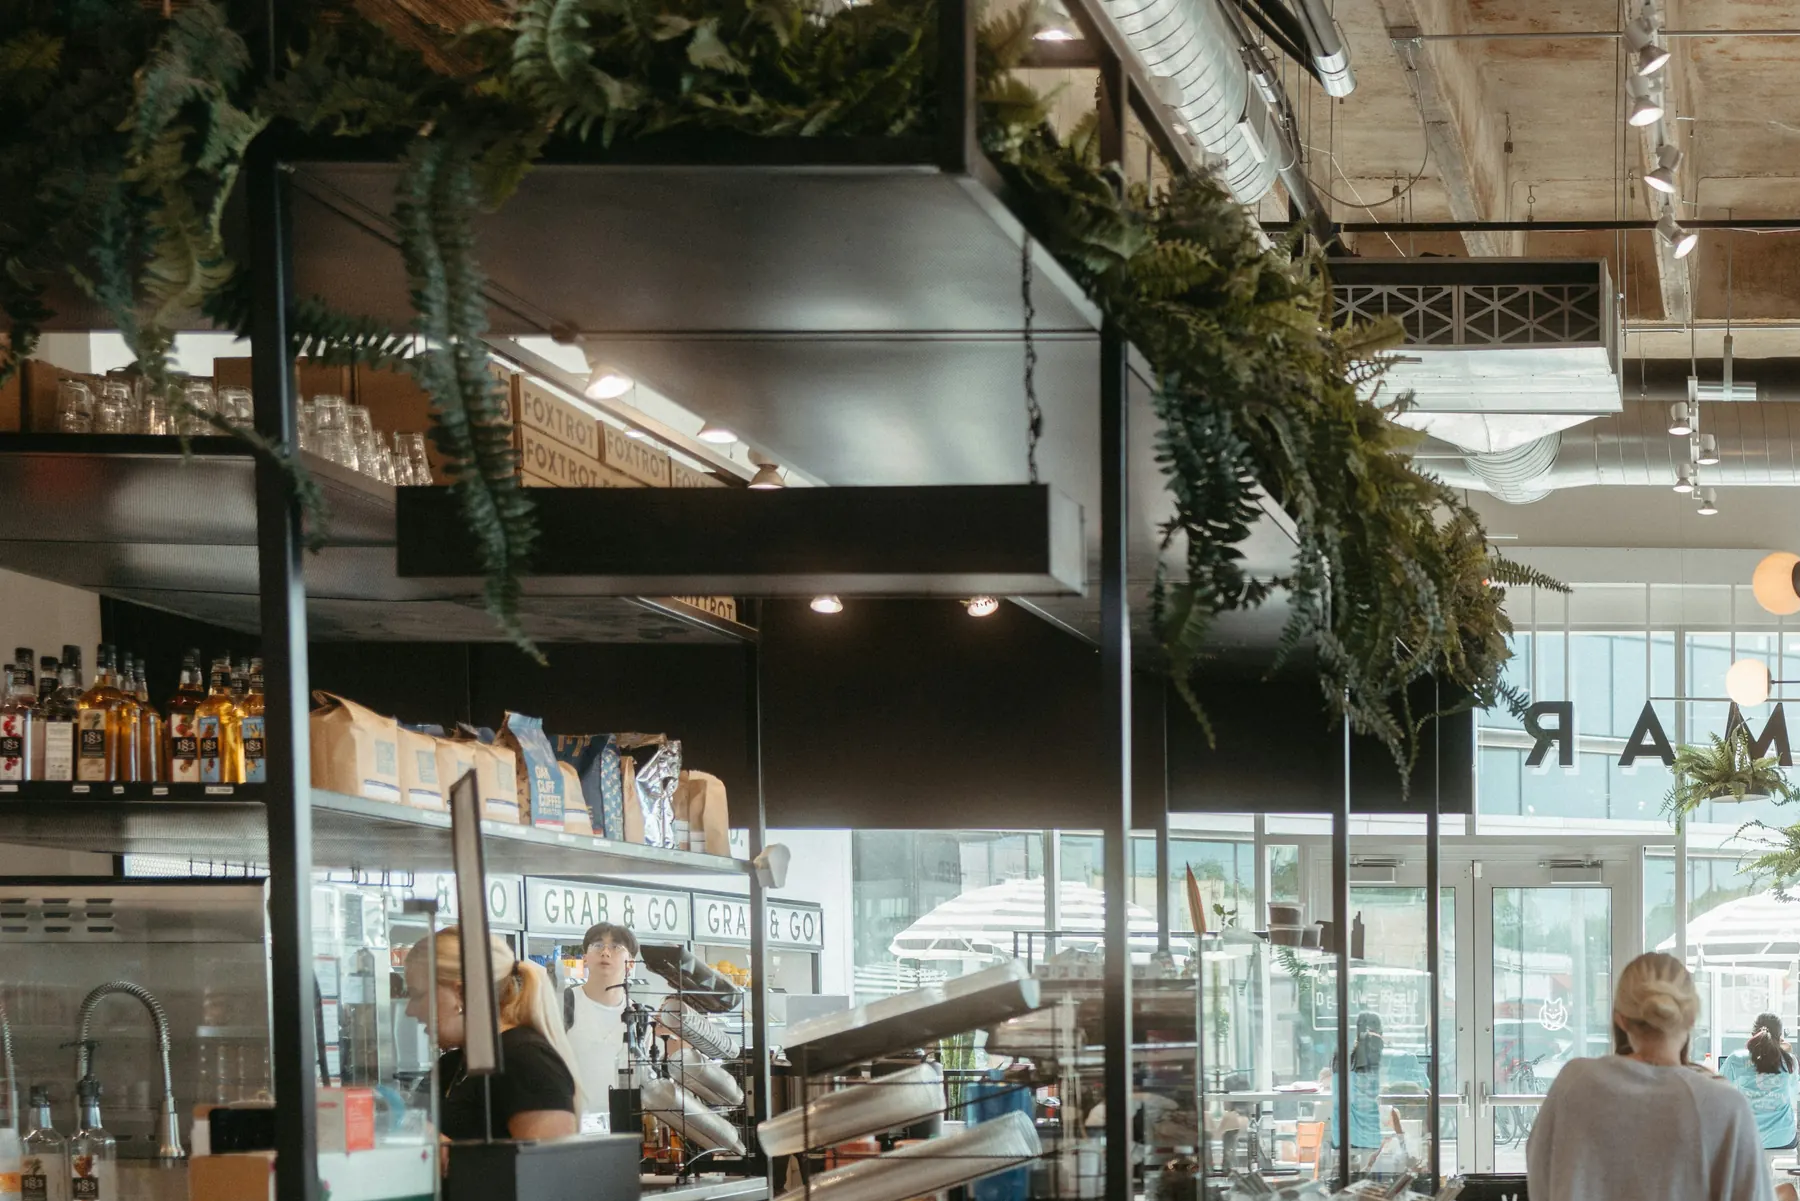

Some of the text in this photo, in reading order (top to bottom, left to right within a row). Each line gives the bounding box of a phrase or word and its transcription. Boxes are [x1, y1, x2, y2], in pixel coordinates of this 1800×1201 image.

[523, 392, 595, 453] FOXTROT
[606, 429, 667, 482] FOXTROT
[544, 888, 678, 931] GRAB & GO
[708, 903, 814, 942] GRA & GO
